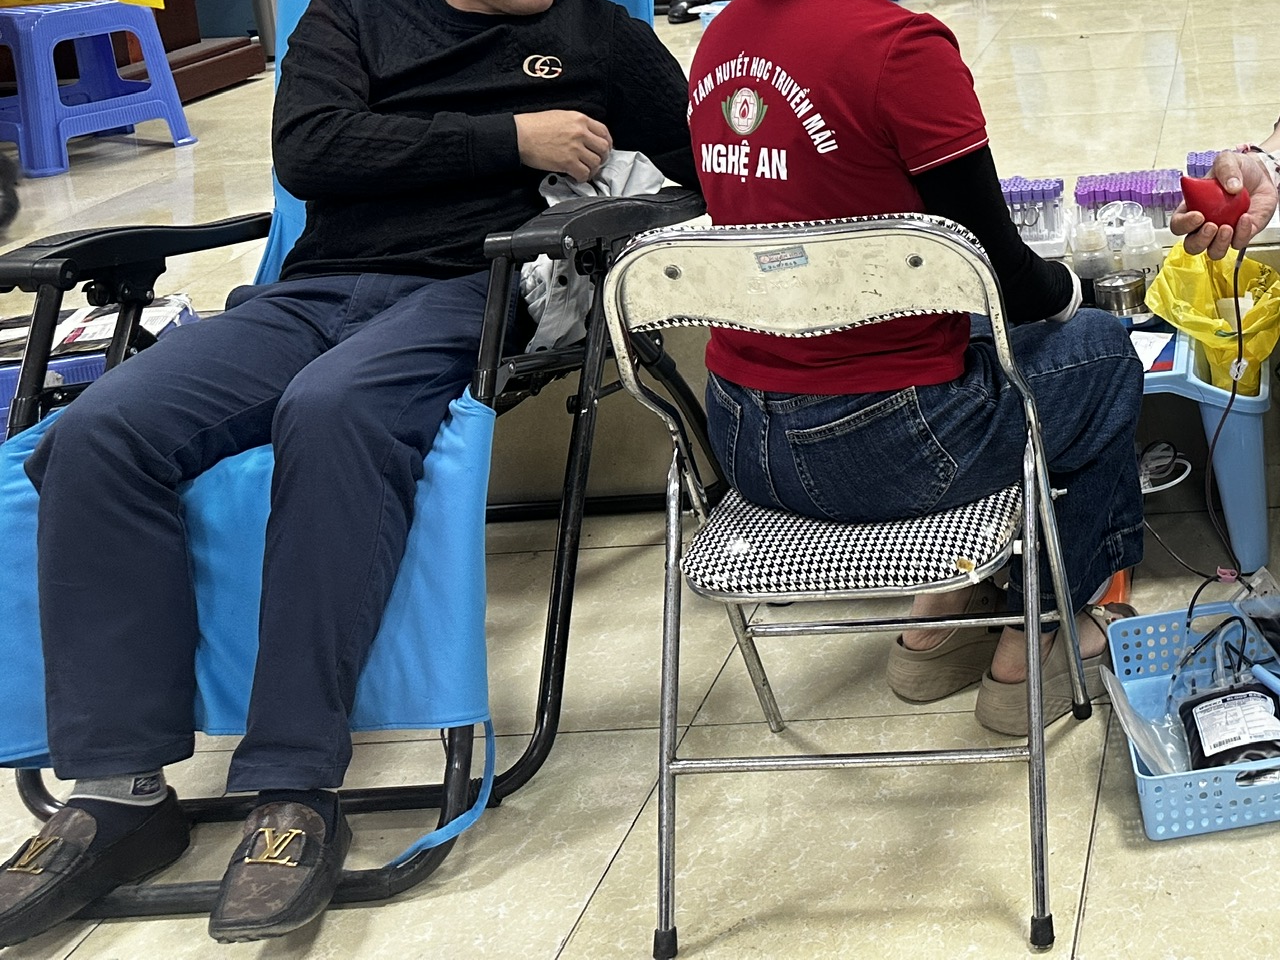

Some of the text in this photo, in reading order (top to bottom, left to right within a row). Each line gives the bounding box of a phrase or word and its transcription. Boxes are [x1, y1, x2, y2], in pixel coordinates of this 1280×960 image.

[693, 50, 838, 154] TÂM HUYẾT HỌC TRUYỀN MÁU
[701, 139, 788, 182] NGHỆ AN
